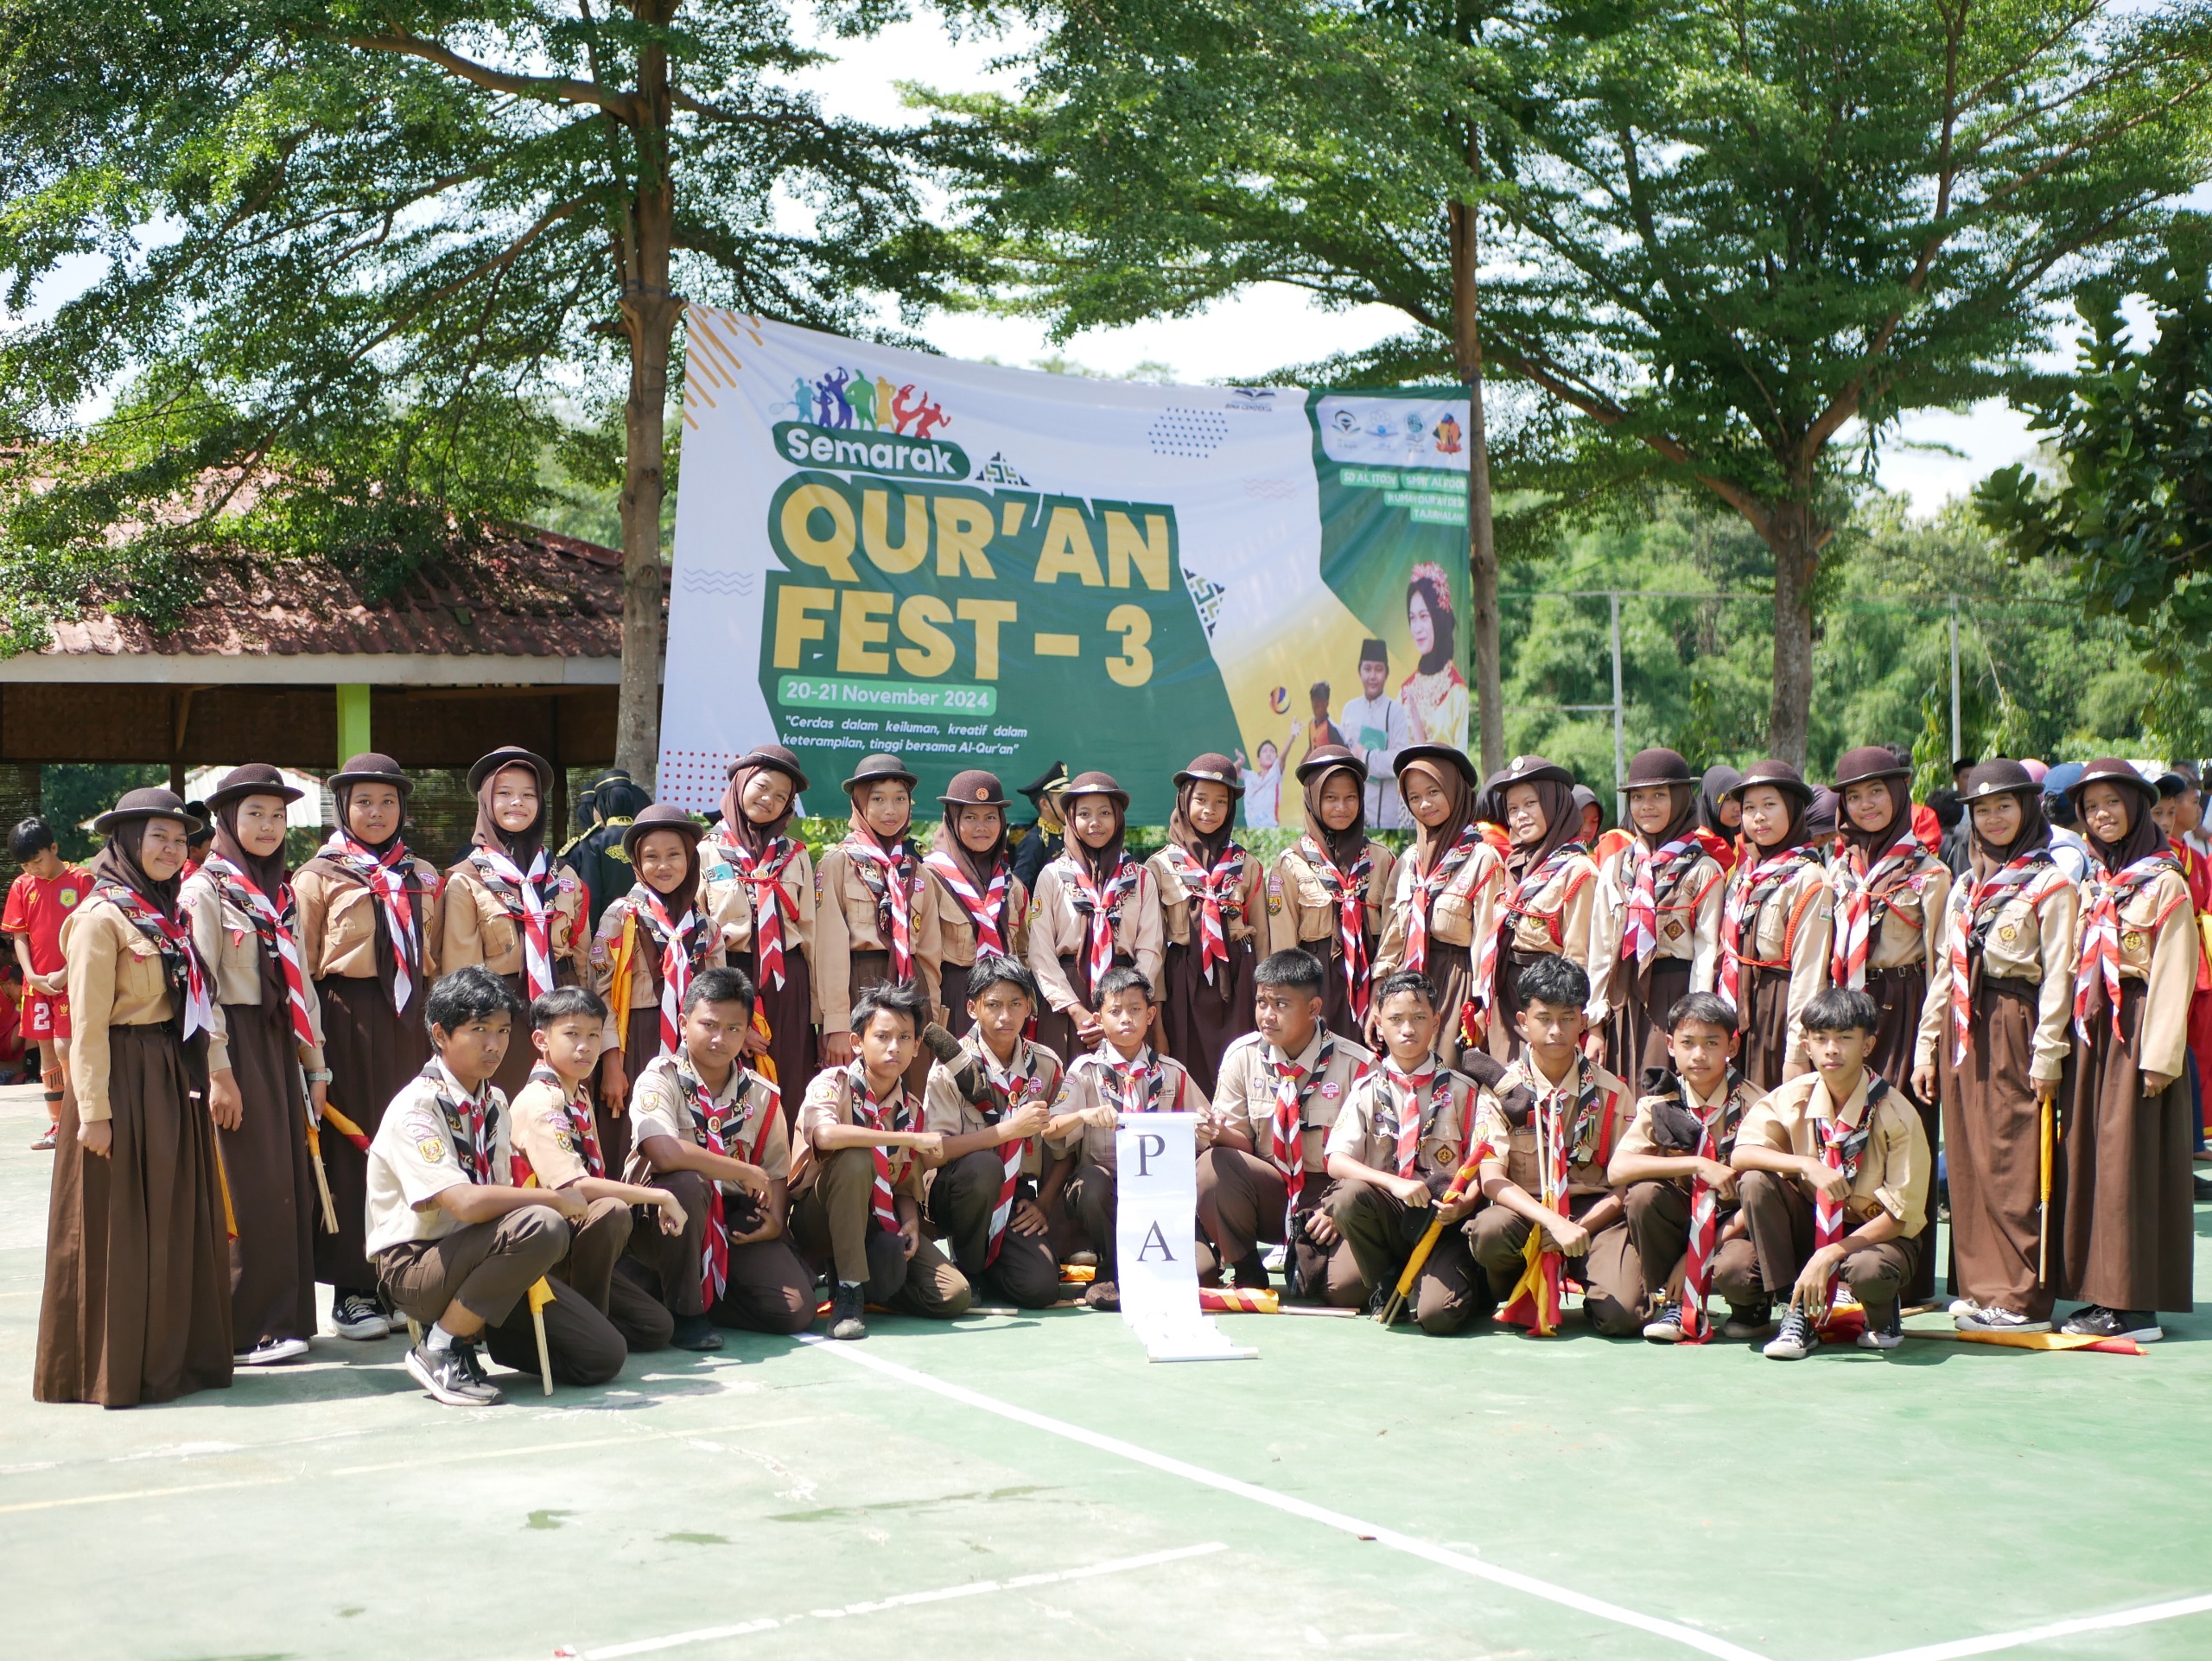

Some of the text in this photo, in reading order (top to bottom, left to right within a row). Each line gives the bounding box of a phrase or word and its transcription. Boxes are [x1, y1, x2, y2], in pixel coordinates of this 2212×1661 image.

[786, 428, 957, 475] Semarak
[781, 484, 1171, 591] QUR'AN
[773, 585, 1017, 681] FEST
[1105, 604, 1154, 688] 3
[785, 681, 989, 709] 20-21 November 2024
[782, 733, 866, 751] keterampilan,
[869, 737, 904, 754] tinggi
[906, 739, 957, 754] bersama
[785, 715, 1028, 738] "Cerdas dalam keiluman, kreatif dalam
[34, 1002, 51, 1031] 2
[1134, 1134, 1166, 1177] P
[1135, 1219, 1179, 1263] A
